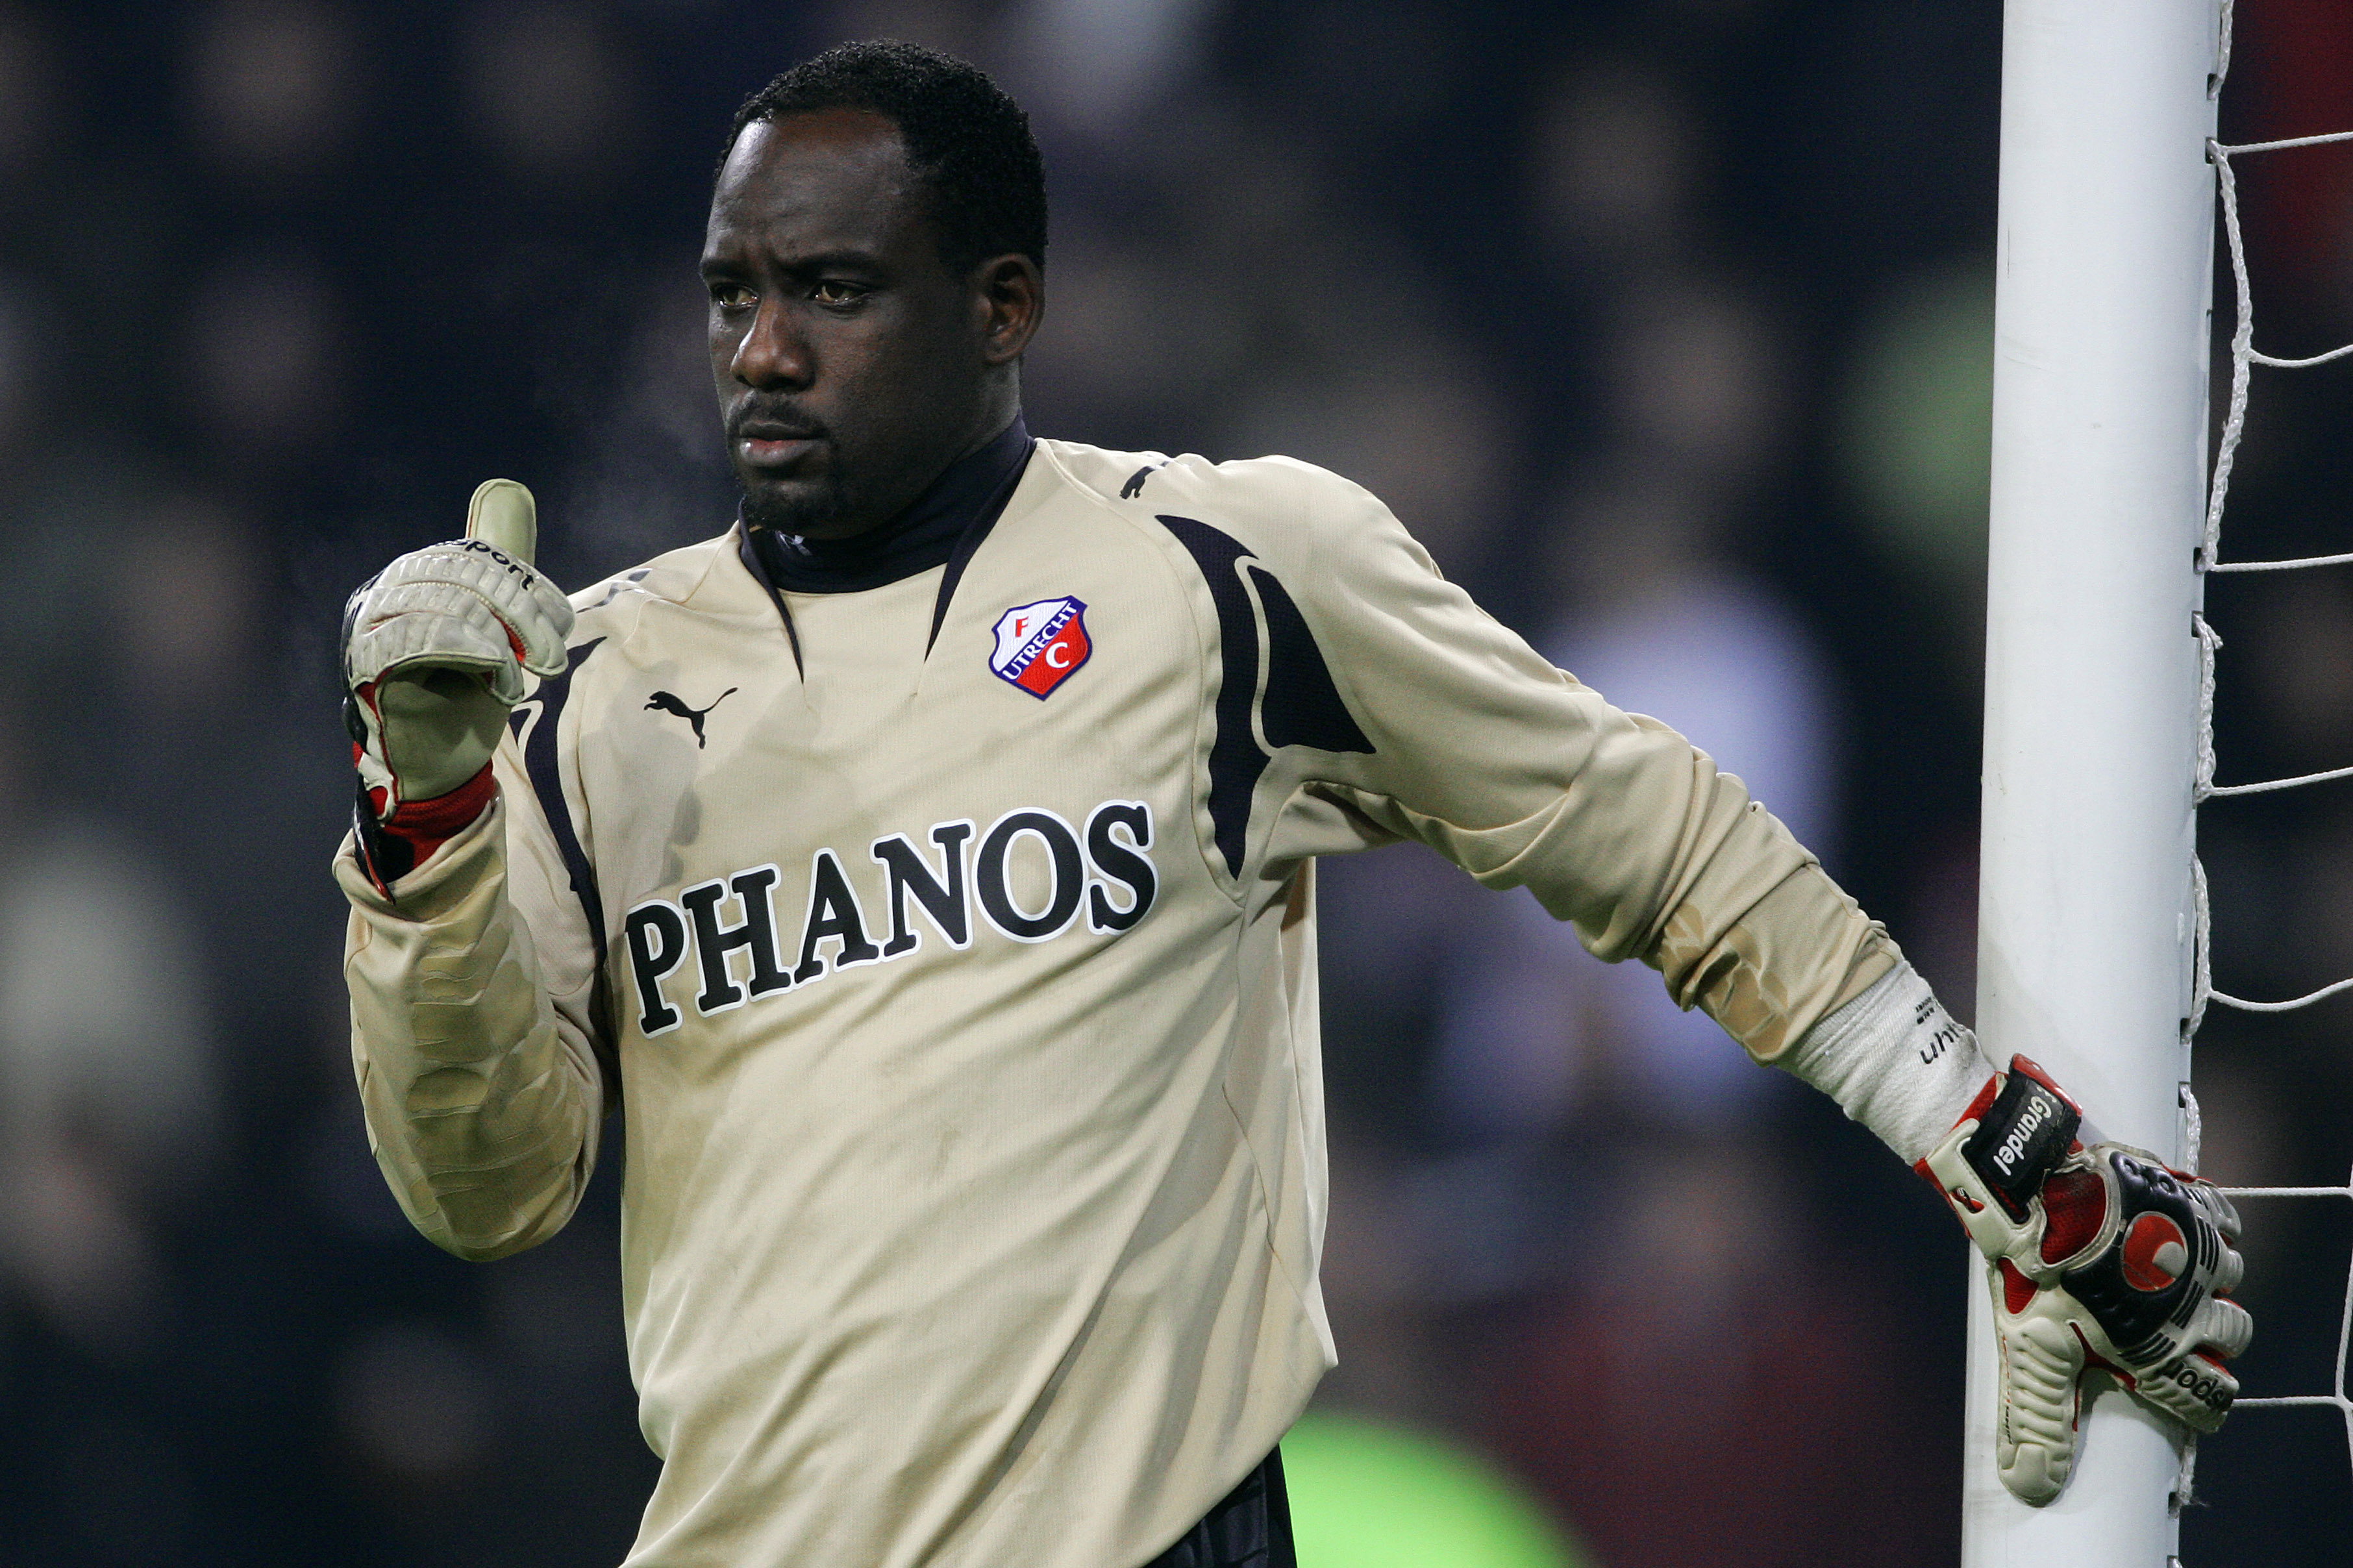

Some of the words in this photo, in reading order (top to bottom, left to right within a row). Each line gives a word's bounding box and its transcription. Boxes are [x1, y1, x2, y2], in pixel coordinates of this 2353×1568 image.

[1002, 603, 1077, 680] UTRECHT
[1015, 616, 1029, 638] F
[1045, 641, 1070, 669] C
[624, 799, 1160, 1039] PHANOS
[1993, 1095, 2052, 1176] Grandel
